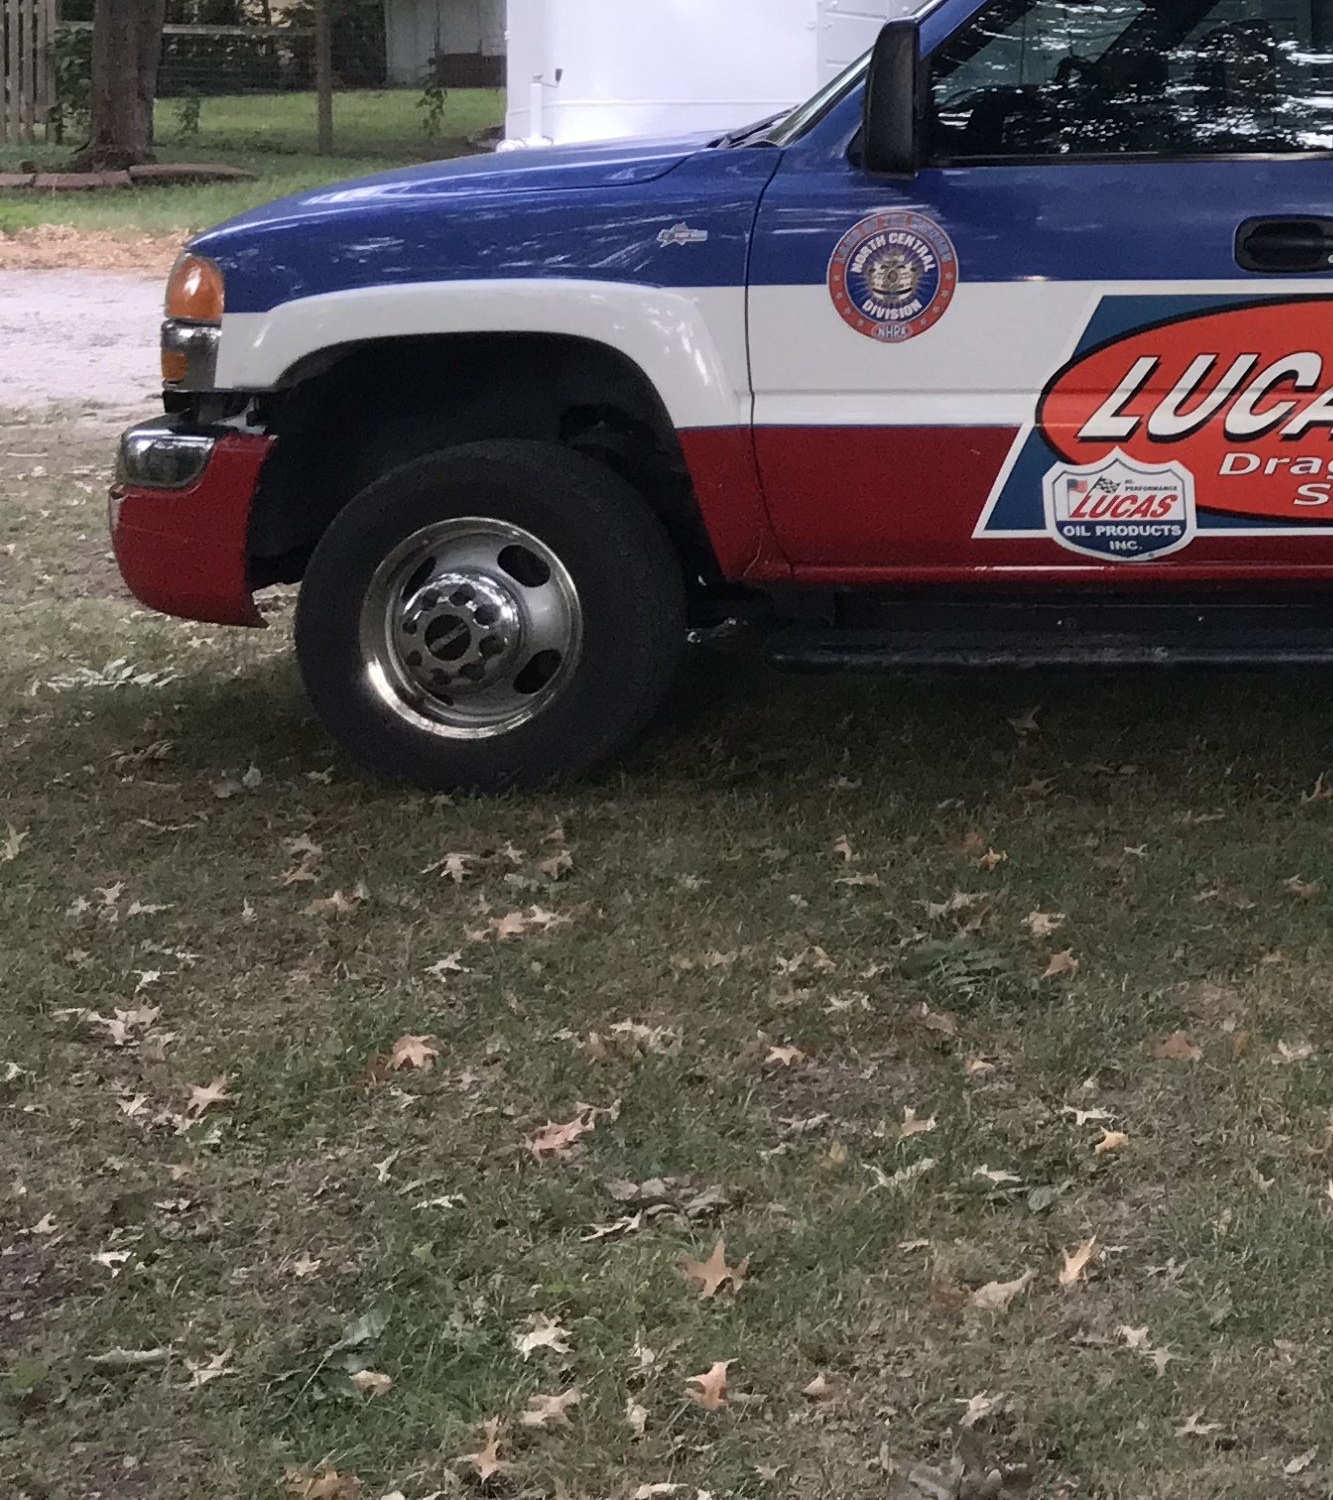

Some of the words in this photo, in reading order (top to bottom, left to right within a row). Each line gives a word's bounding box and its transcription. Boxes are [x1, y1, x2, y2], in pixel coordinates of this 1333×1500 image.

[850, 234, 887, 274] NORTH
[888, 231, 937, 273] CENTRAL
[861, 299, 923, 320] DIVISION
[877, 325, 907, 338] NHRA
[1069, 494, 1178, 519] LUCAS
[1063, 525, 1091, 537] OIL
[1095, 524, 1183, 537] PRODUCTS
[1109, 541, 1143, 551] INC.
